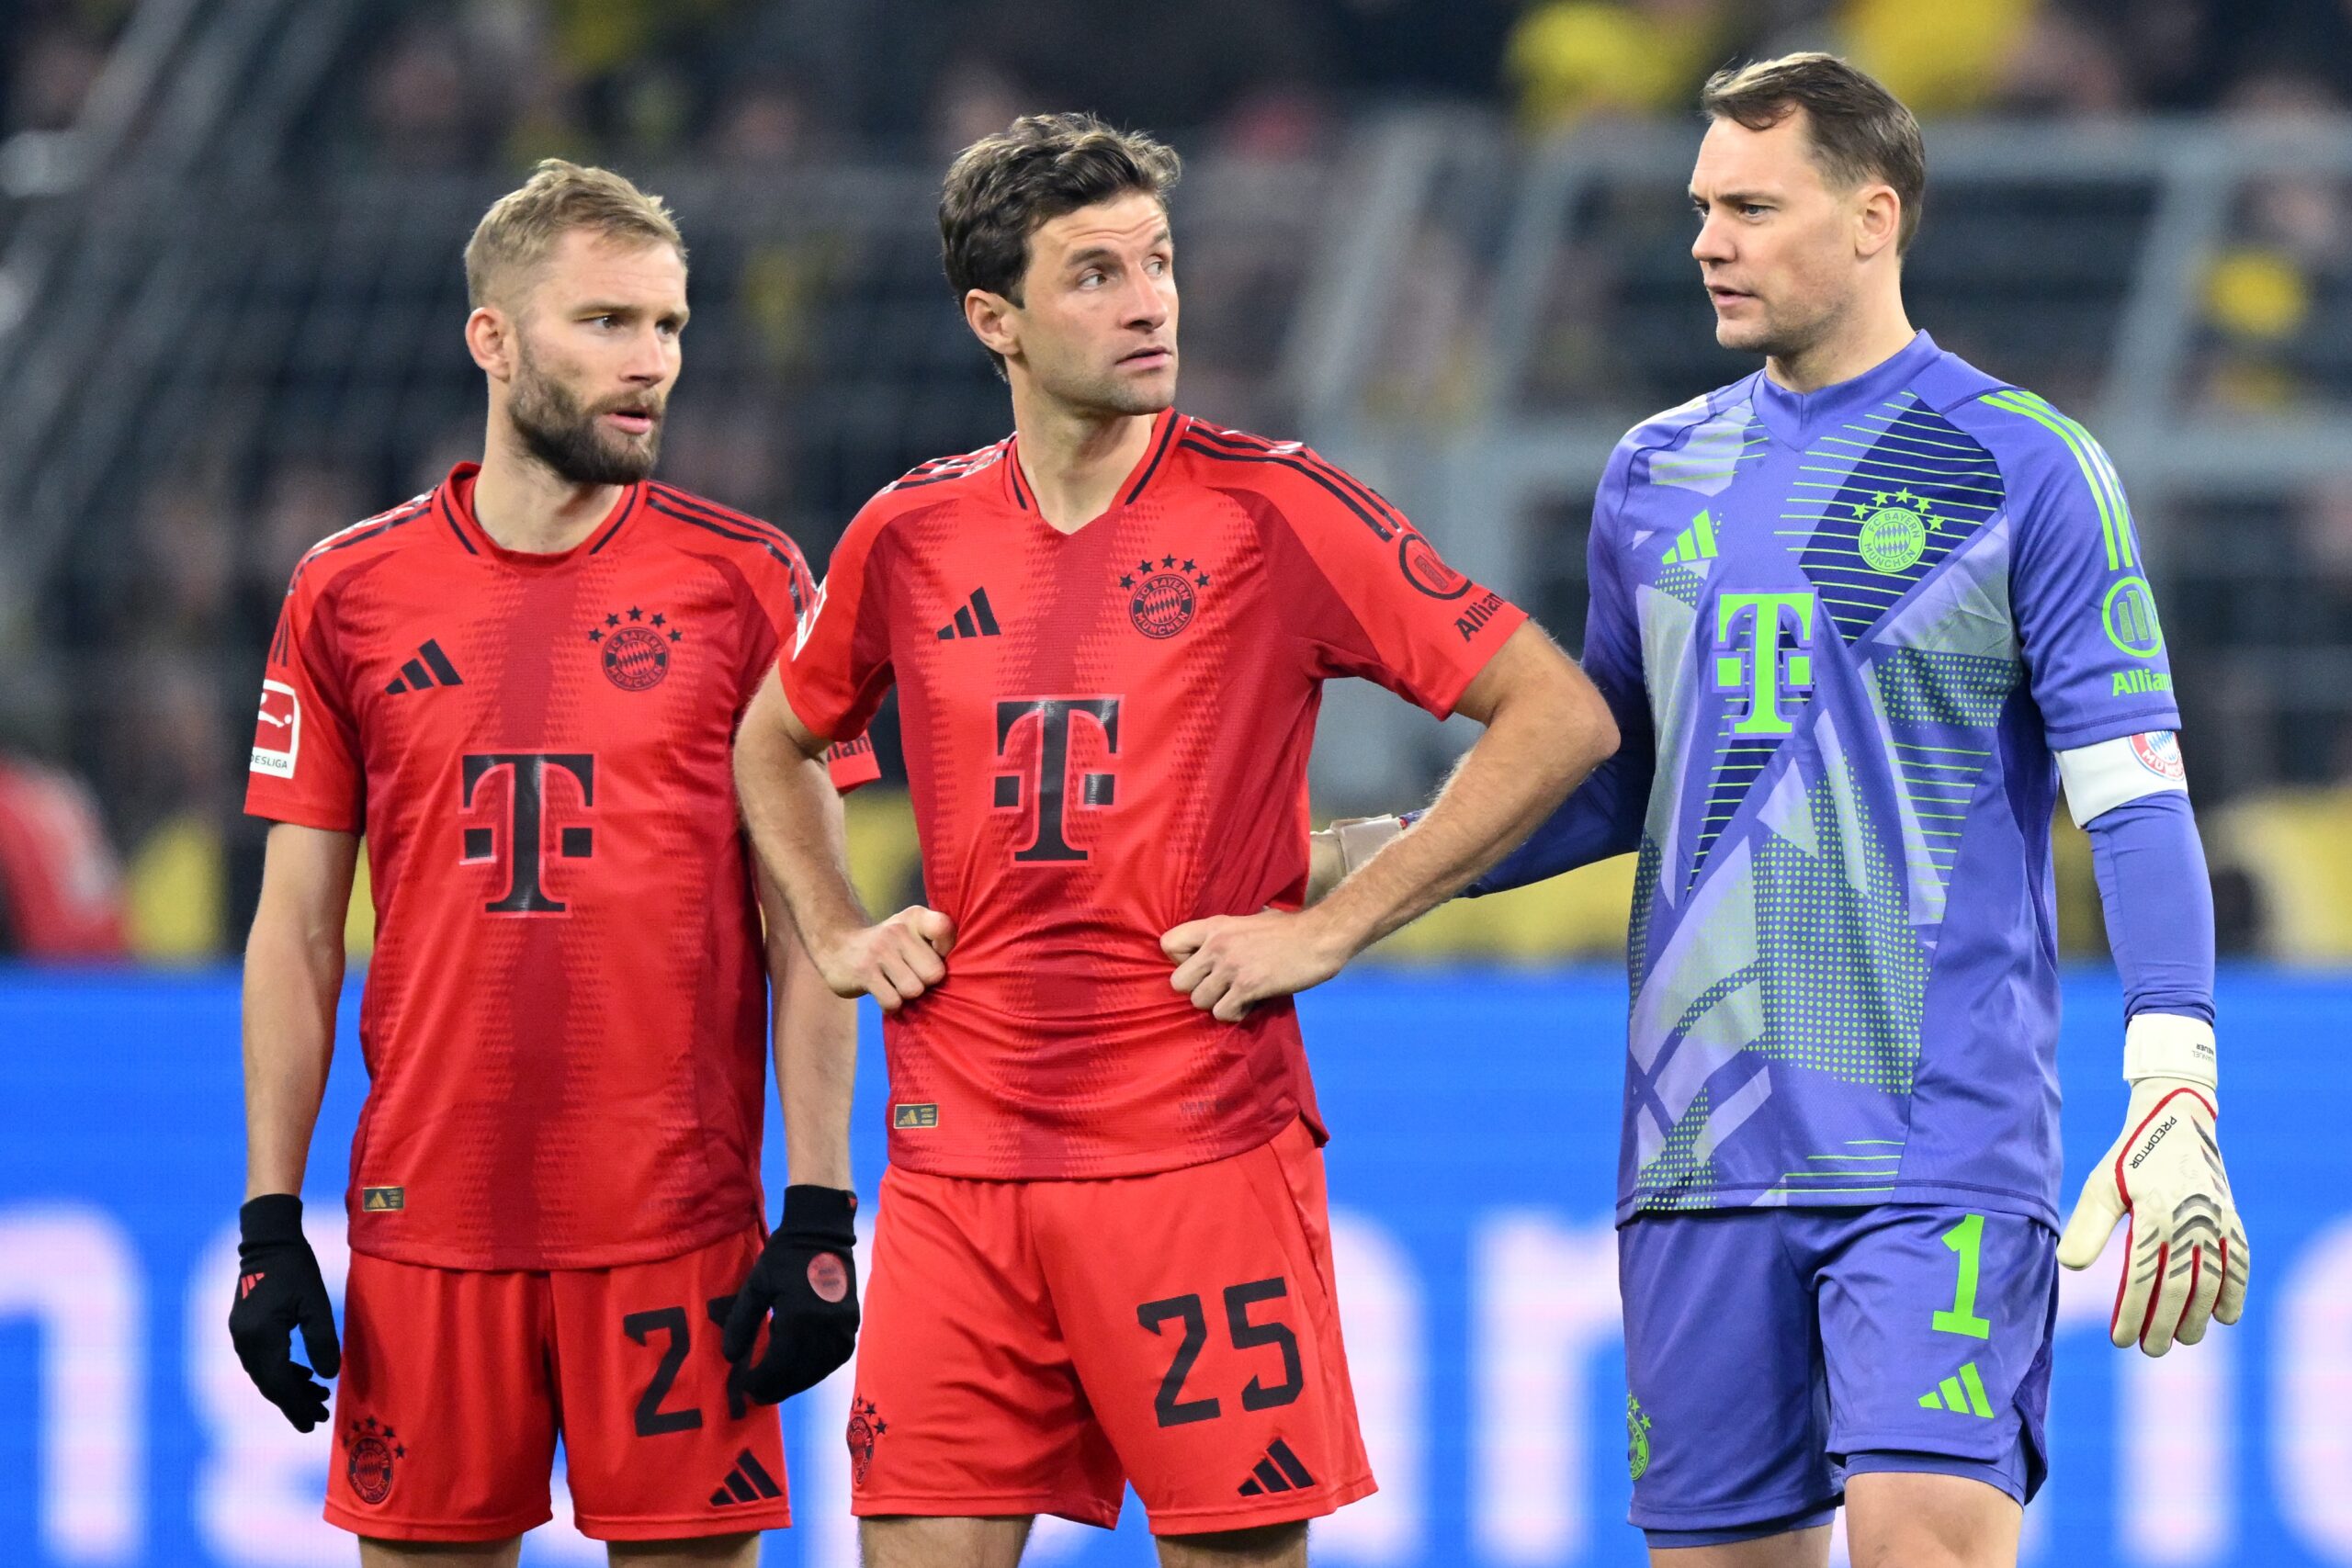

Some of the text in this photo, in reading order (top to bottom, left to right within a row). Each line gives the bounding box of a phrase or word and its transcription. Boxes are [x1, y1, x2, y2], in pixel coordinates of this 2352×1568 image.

[1151, 577, 1191, 600] BAYERN
[1884, 513, 1920, 538] BAYERN
[1717, 592, 1814, 733] T
[462, 754, 594, 912] T
[994, 700, 1119, 861] T
[2129, 1115, 2177, 1169] PREDATOR
[1932, 1213, 1990, 1339] 1
[1136, 1277, 1304, 1428] 25
